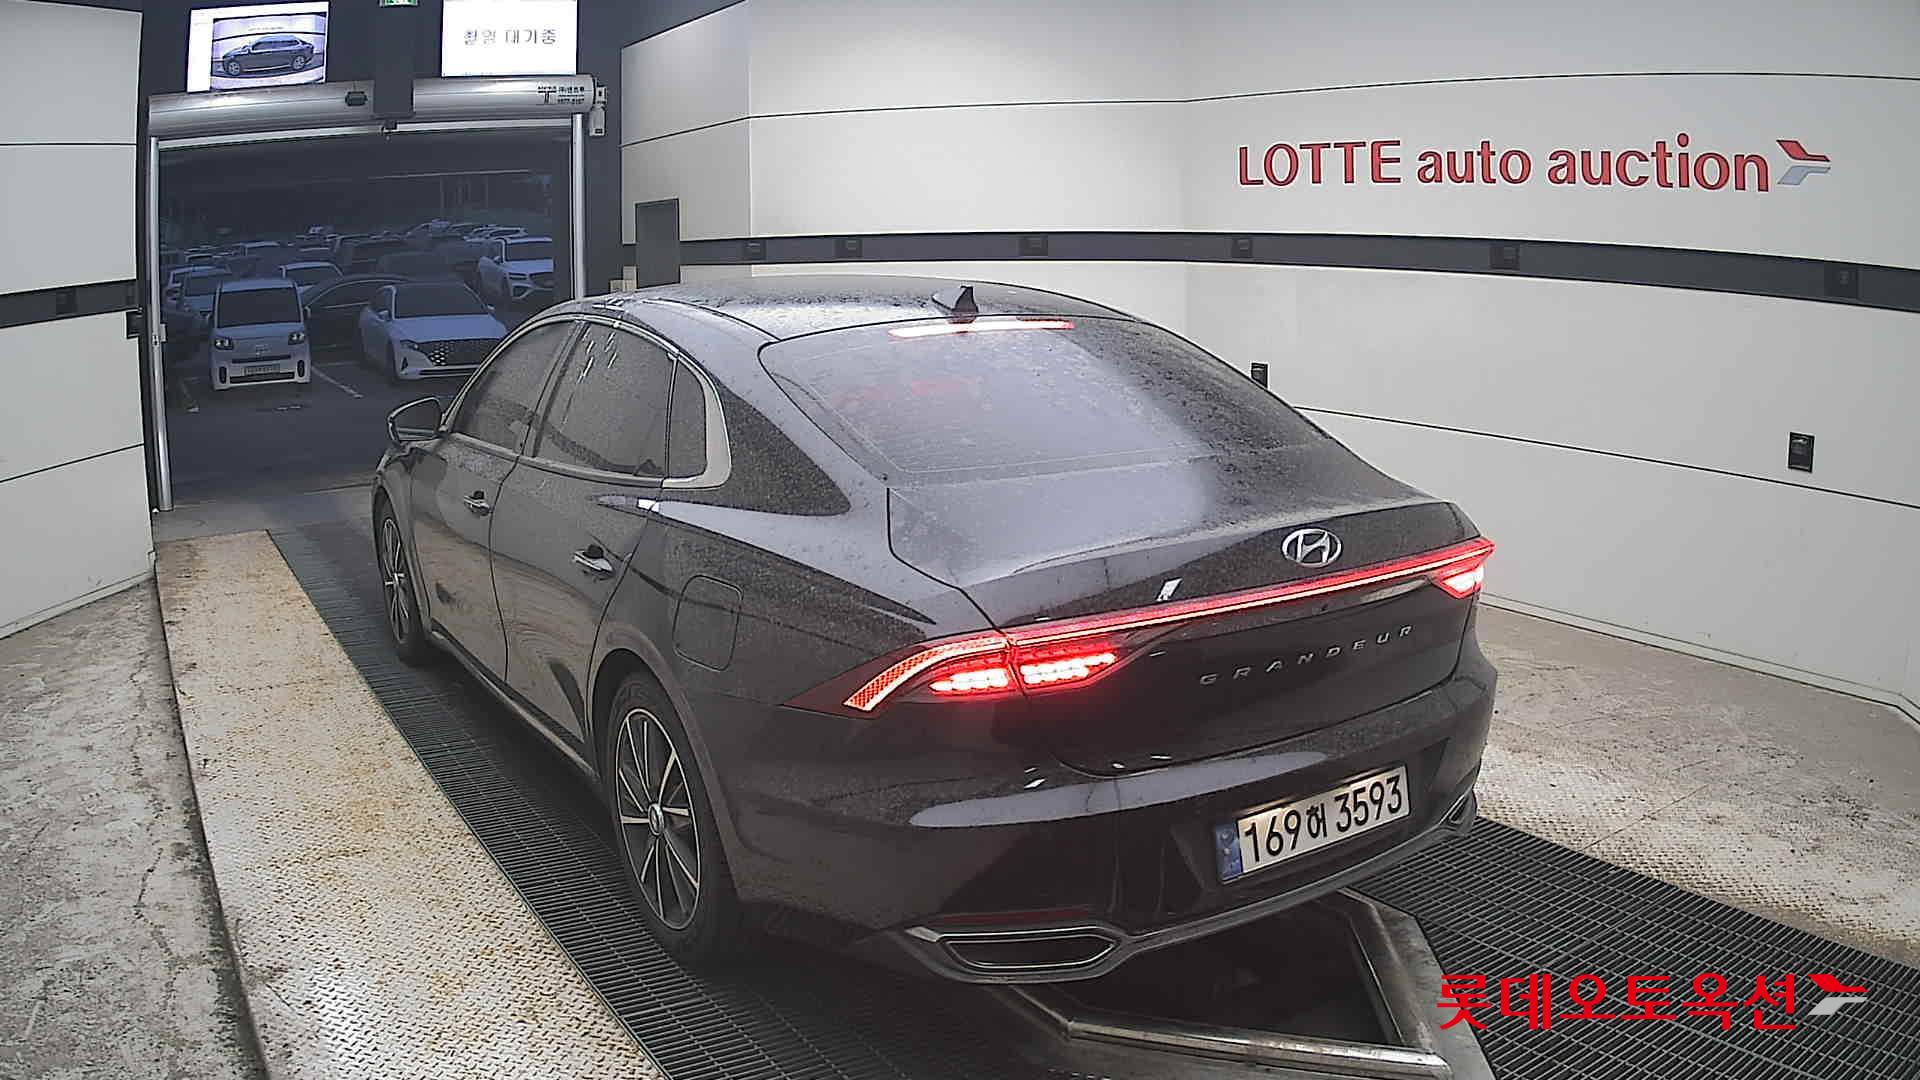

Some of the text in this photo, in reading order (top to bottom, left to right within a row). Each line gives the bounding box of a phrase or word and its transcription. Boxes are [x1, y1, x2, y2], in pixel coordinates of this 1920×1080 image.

[504, 28, 558, 45] 대기중
[1238, 134, 1769, 192] LOTTE auto auction
[1200, 625, 1413, 685] GRANDEUR
[1244, 774, 1402, 863] 169허 3593
